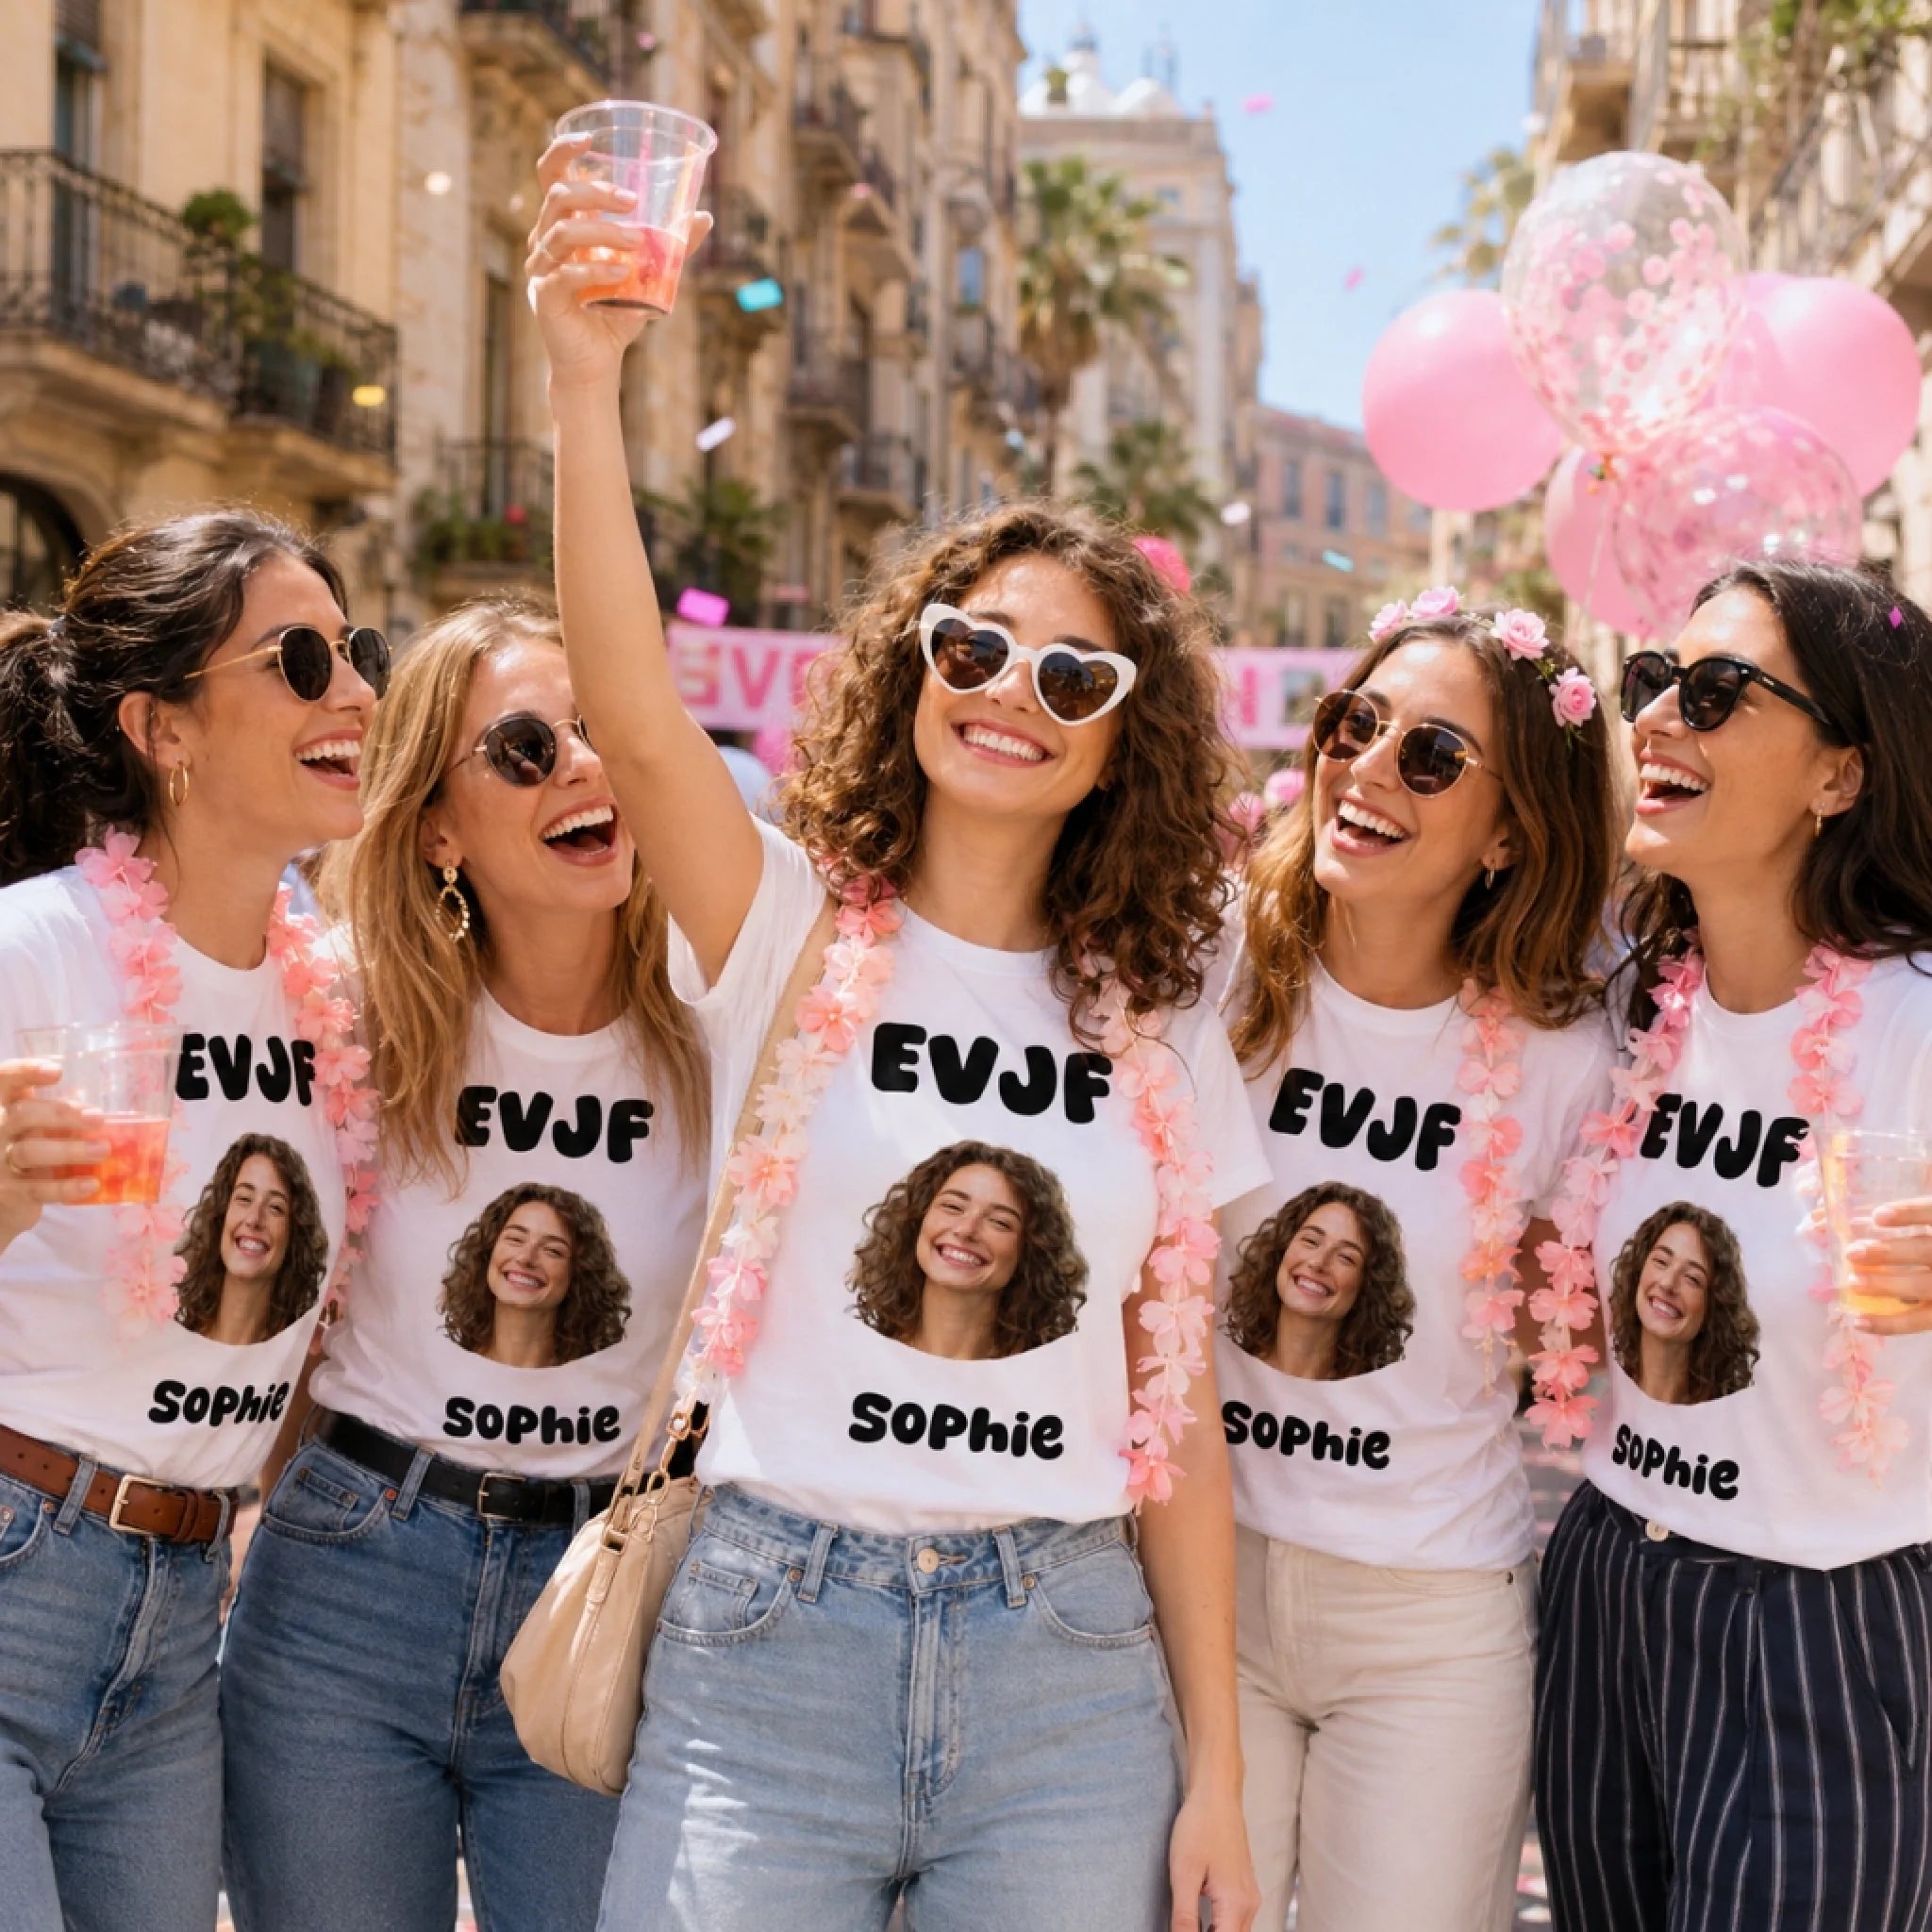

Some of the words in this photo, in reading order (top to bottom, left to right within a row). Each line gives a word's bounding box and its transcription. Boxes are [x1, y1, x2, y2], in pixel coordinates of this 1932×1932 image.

[175, 1032, 316, 1107] EVJF
[870, 1021, 1112, 1124] EVJF
[455, 1085, 655, 1163] EVJF
[1269, 1066, 1462, 1171] EVJF
[1640, 1092, 1810, 1188] EVJF
